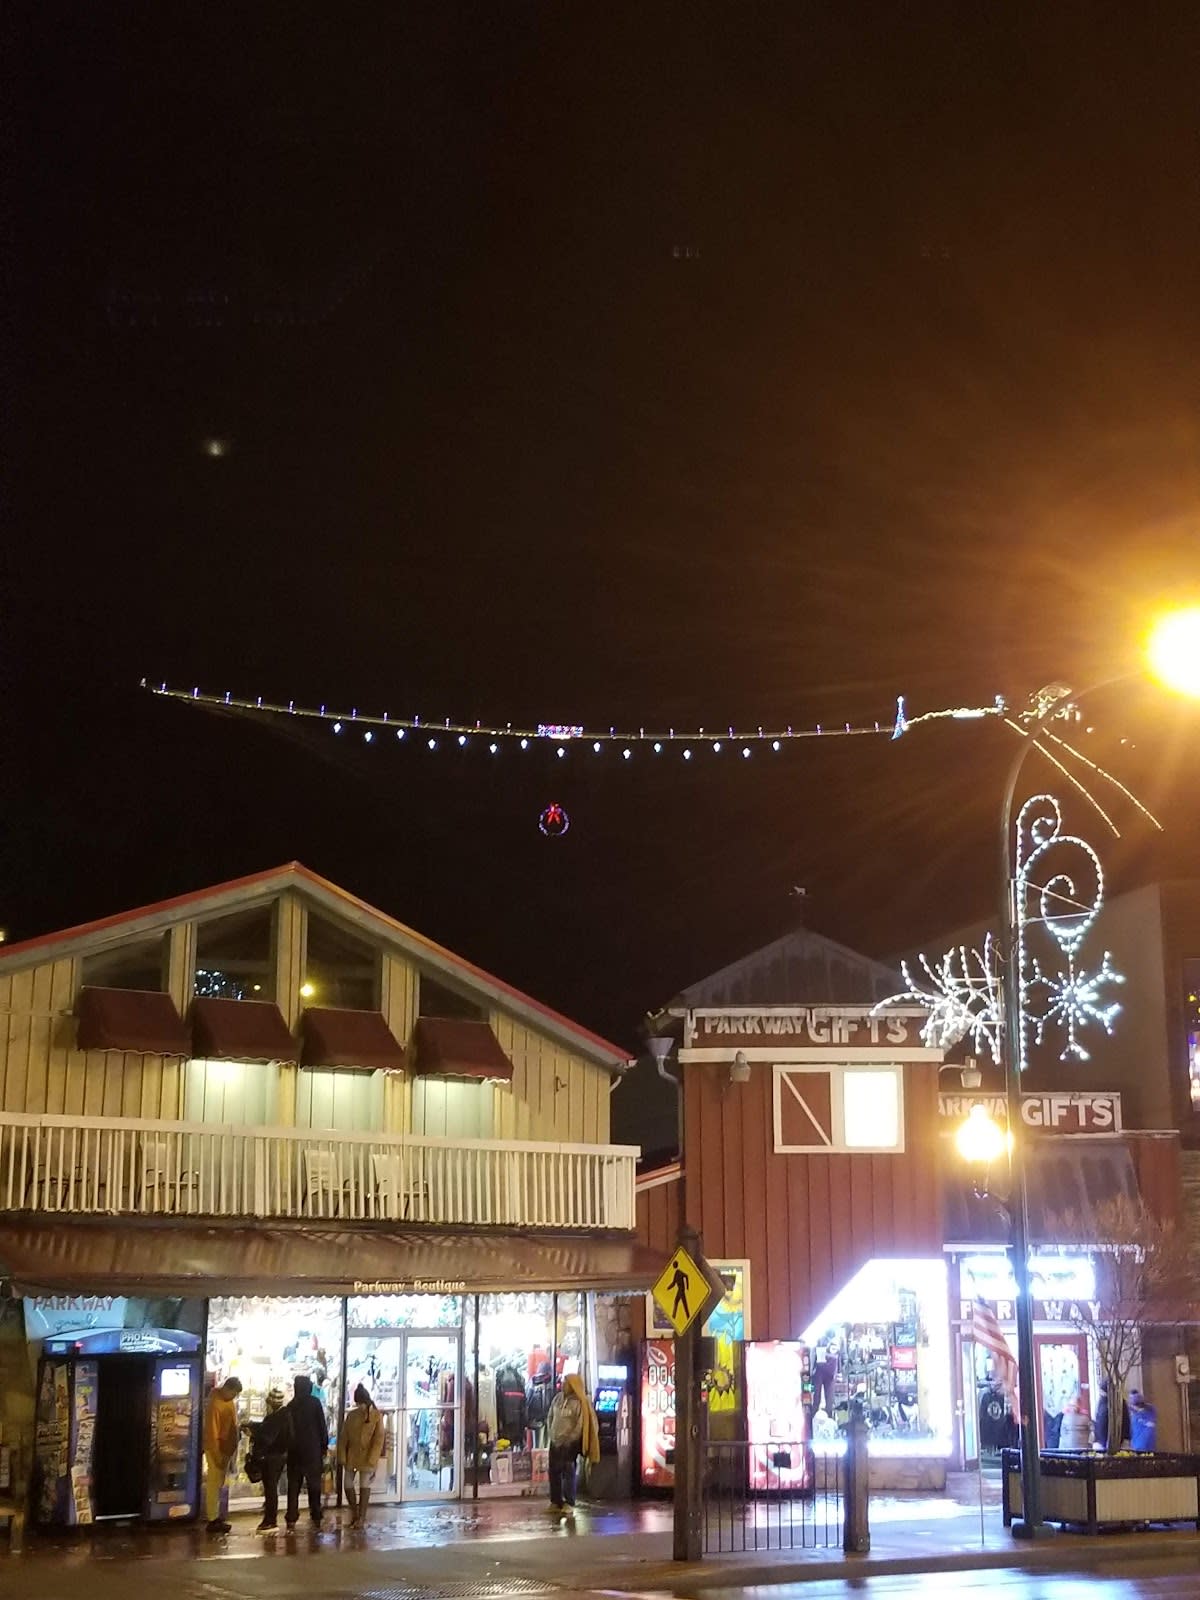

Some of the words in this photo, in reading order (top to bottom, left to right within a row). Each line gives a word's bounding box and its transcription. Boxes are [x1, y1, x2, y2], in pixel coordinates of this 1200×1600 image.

[704, 1016, 806, 1034] PARKWAY
[807, 1014, 908, 1043] GIFTS
[1021, 1098, 1113, 1127] GIFTS
[353, 1280, 406, 1293] Parkway
[413, 1280, 466, 1293] Boutique
[33, 1297, 113, 1311] PARKWAY
